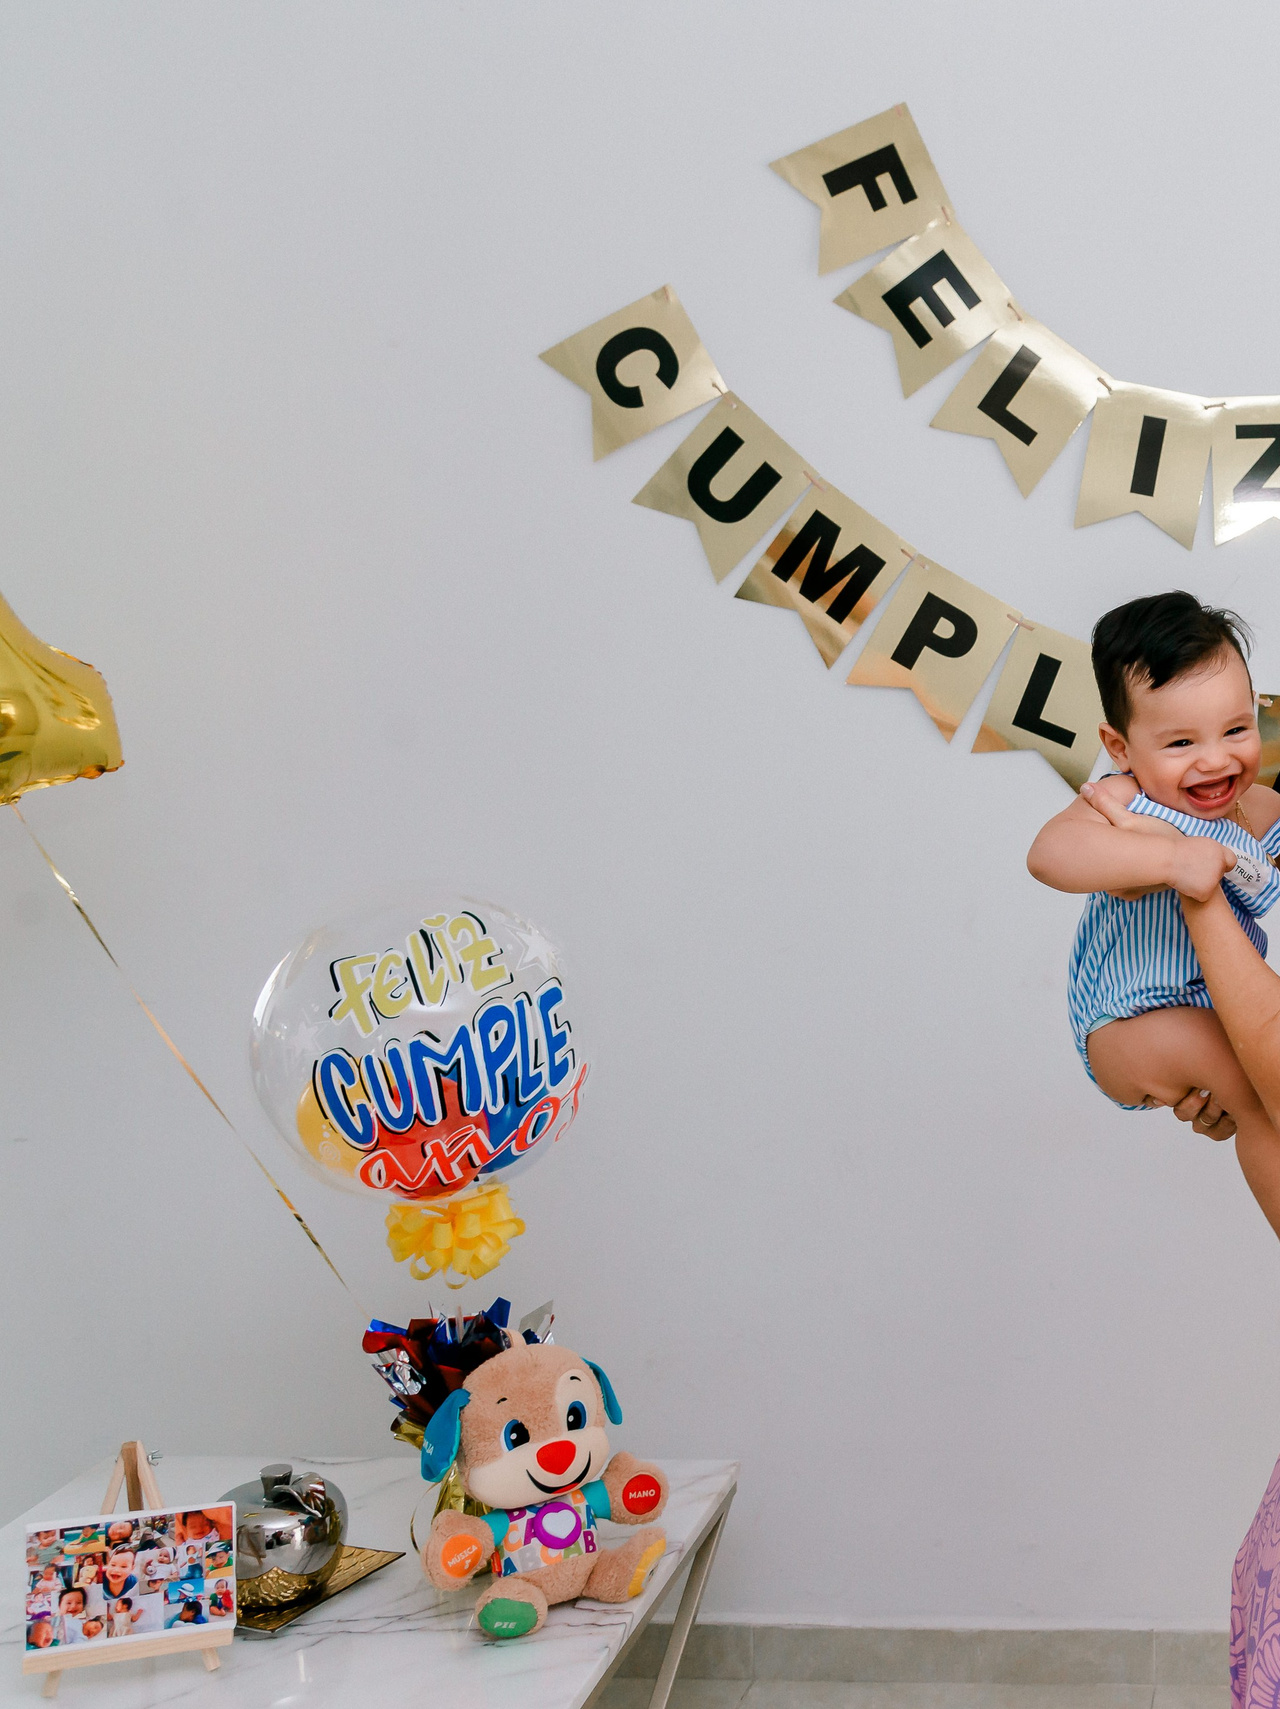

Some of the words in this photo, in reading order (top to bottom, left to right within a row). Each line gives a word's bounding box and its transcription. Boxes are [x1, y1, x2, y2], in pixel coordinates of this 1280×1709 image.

[1234, 864, 1254, 883] TRUE
[314, 980, 573, 1148] CUMPLE
[628, 1488, 656, 1500] MANO
[447, 1544, 479, 1568] MÚSICA
[493, 1621, 517, 1630] PIE
